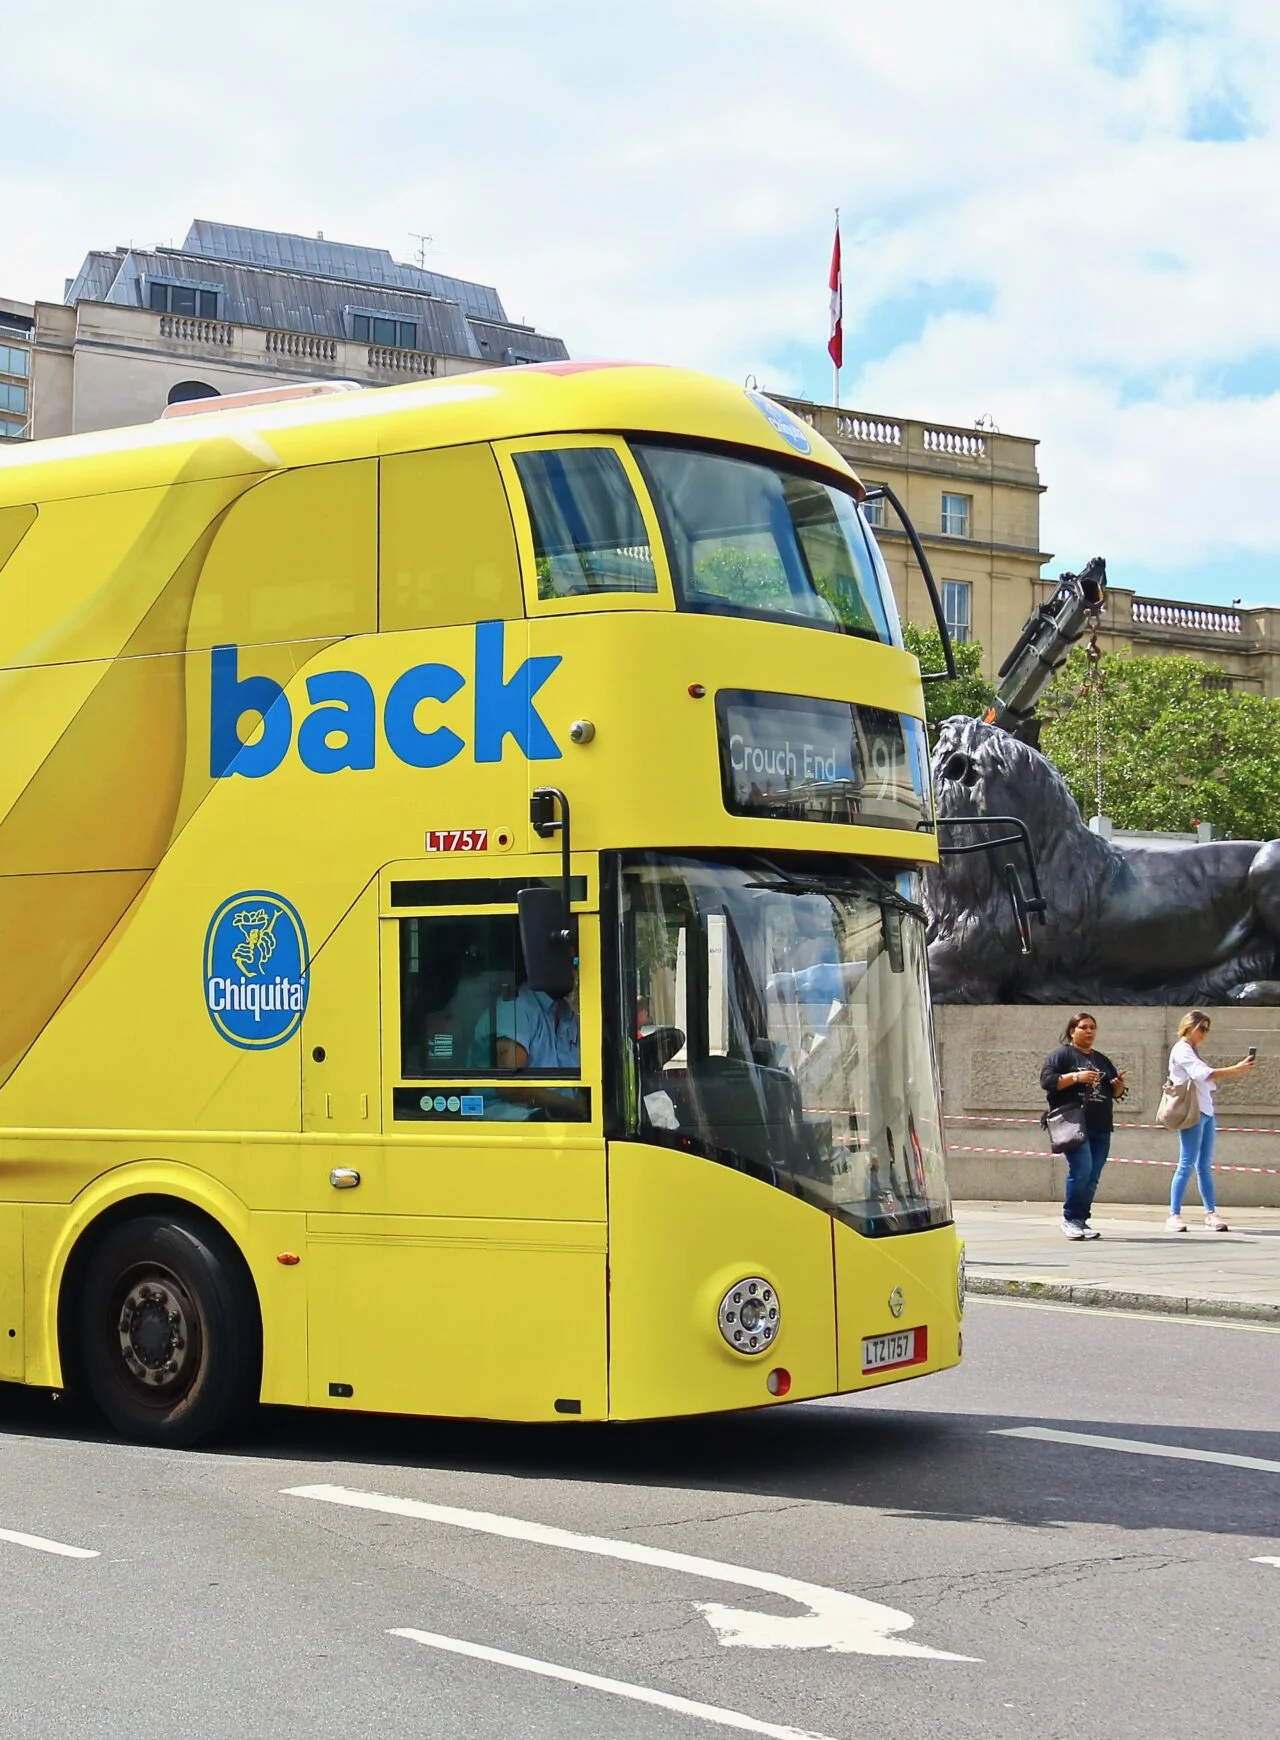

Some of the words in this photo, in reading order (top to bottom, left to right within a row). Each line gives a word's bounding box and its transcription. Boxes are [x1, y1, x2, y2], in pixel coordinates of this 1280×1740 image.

[211, 620, 562, 778] back
[729, 733, 797, 777] Crouch
[803, 743, 837, 781] End
[425, 829, 487, 852] LT757
[208, 976, 304, 1022] Chiquita
